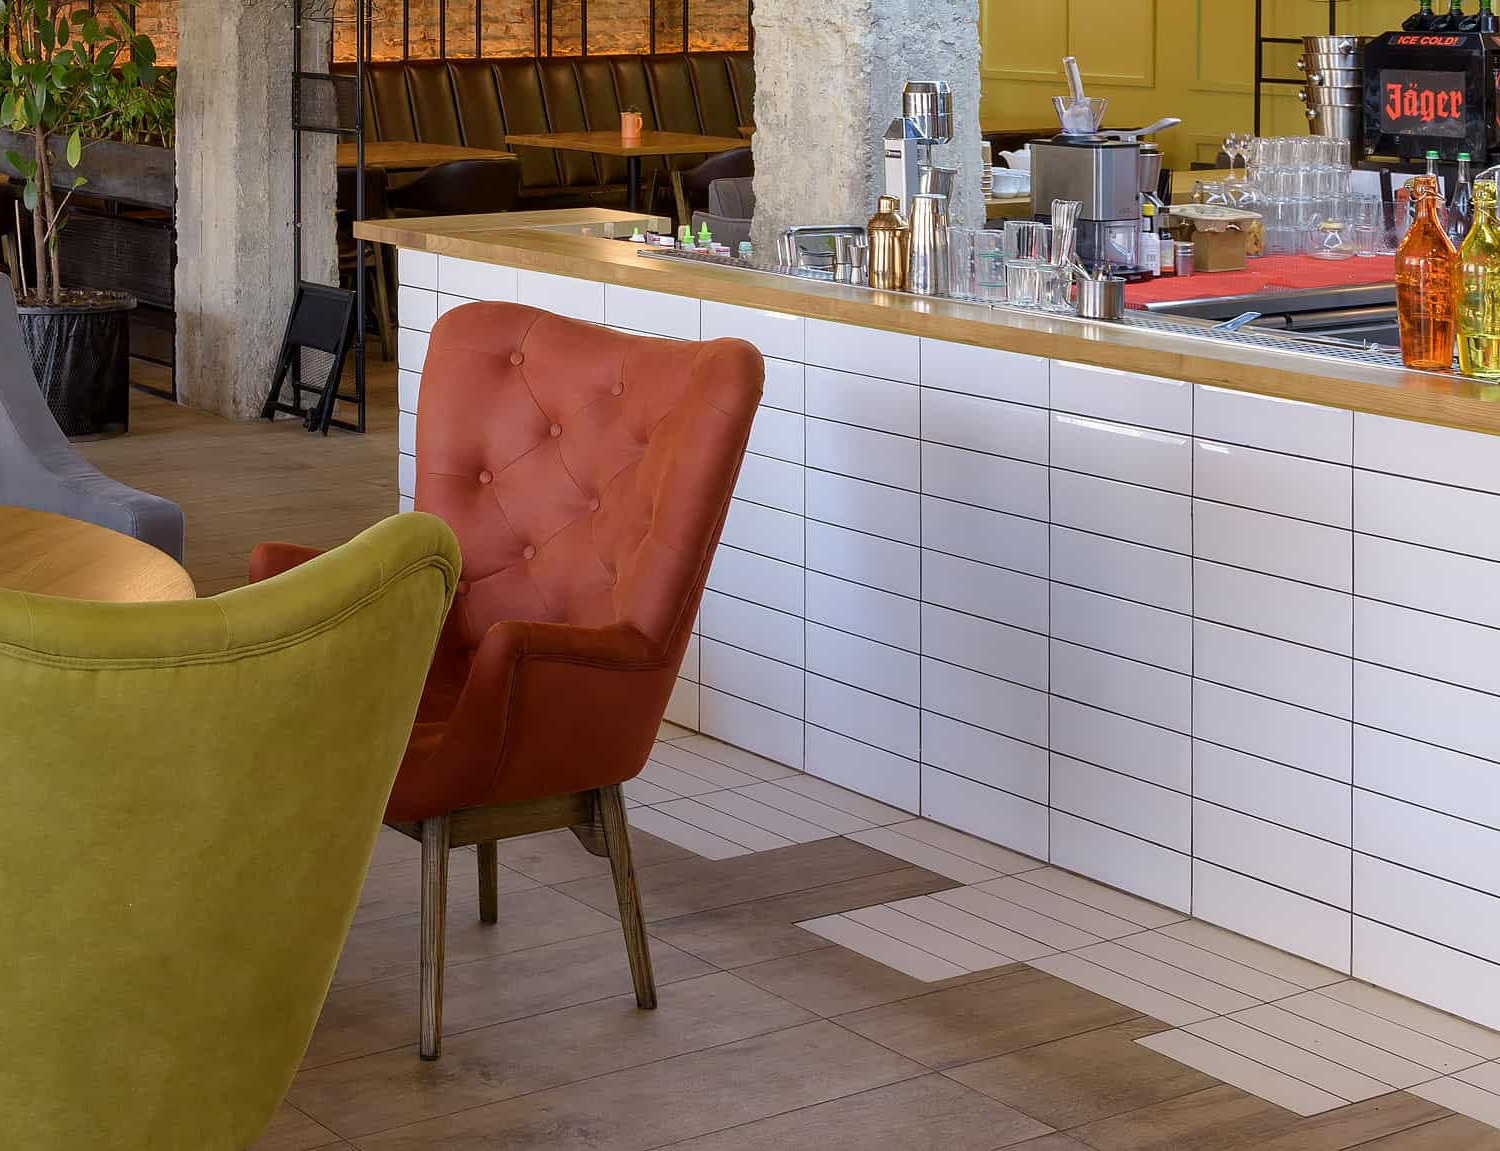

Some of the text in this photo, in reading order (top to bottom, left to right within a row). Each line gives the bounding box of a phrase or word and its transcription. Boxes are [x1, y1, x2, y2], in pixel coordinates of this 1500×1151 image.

[1397, 35, 1458, 46] ICE COLD!
[1385, 82, 1463, 122] Jäger
